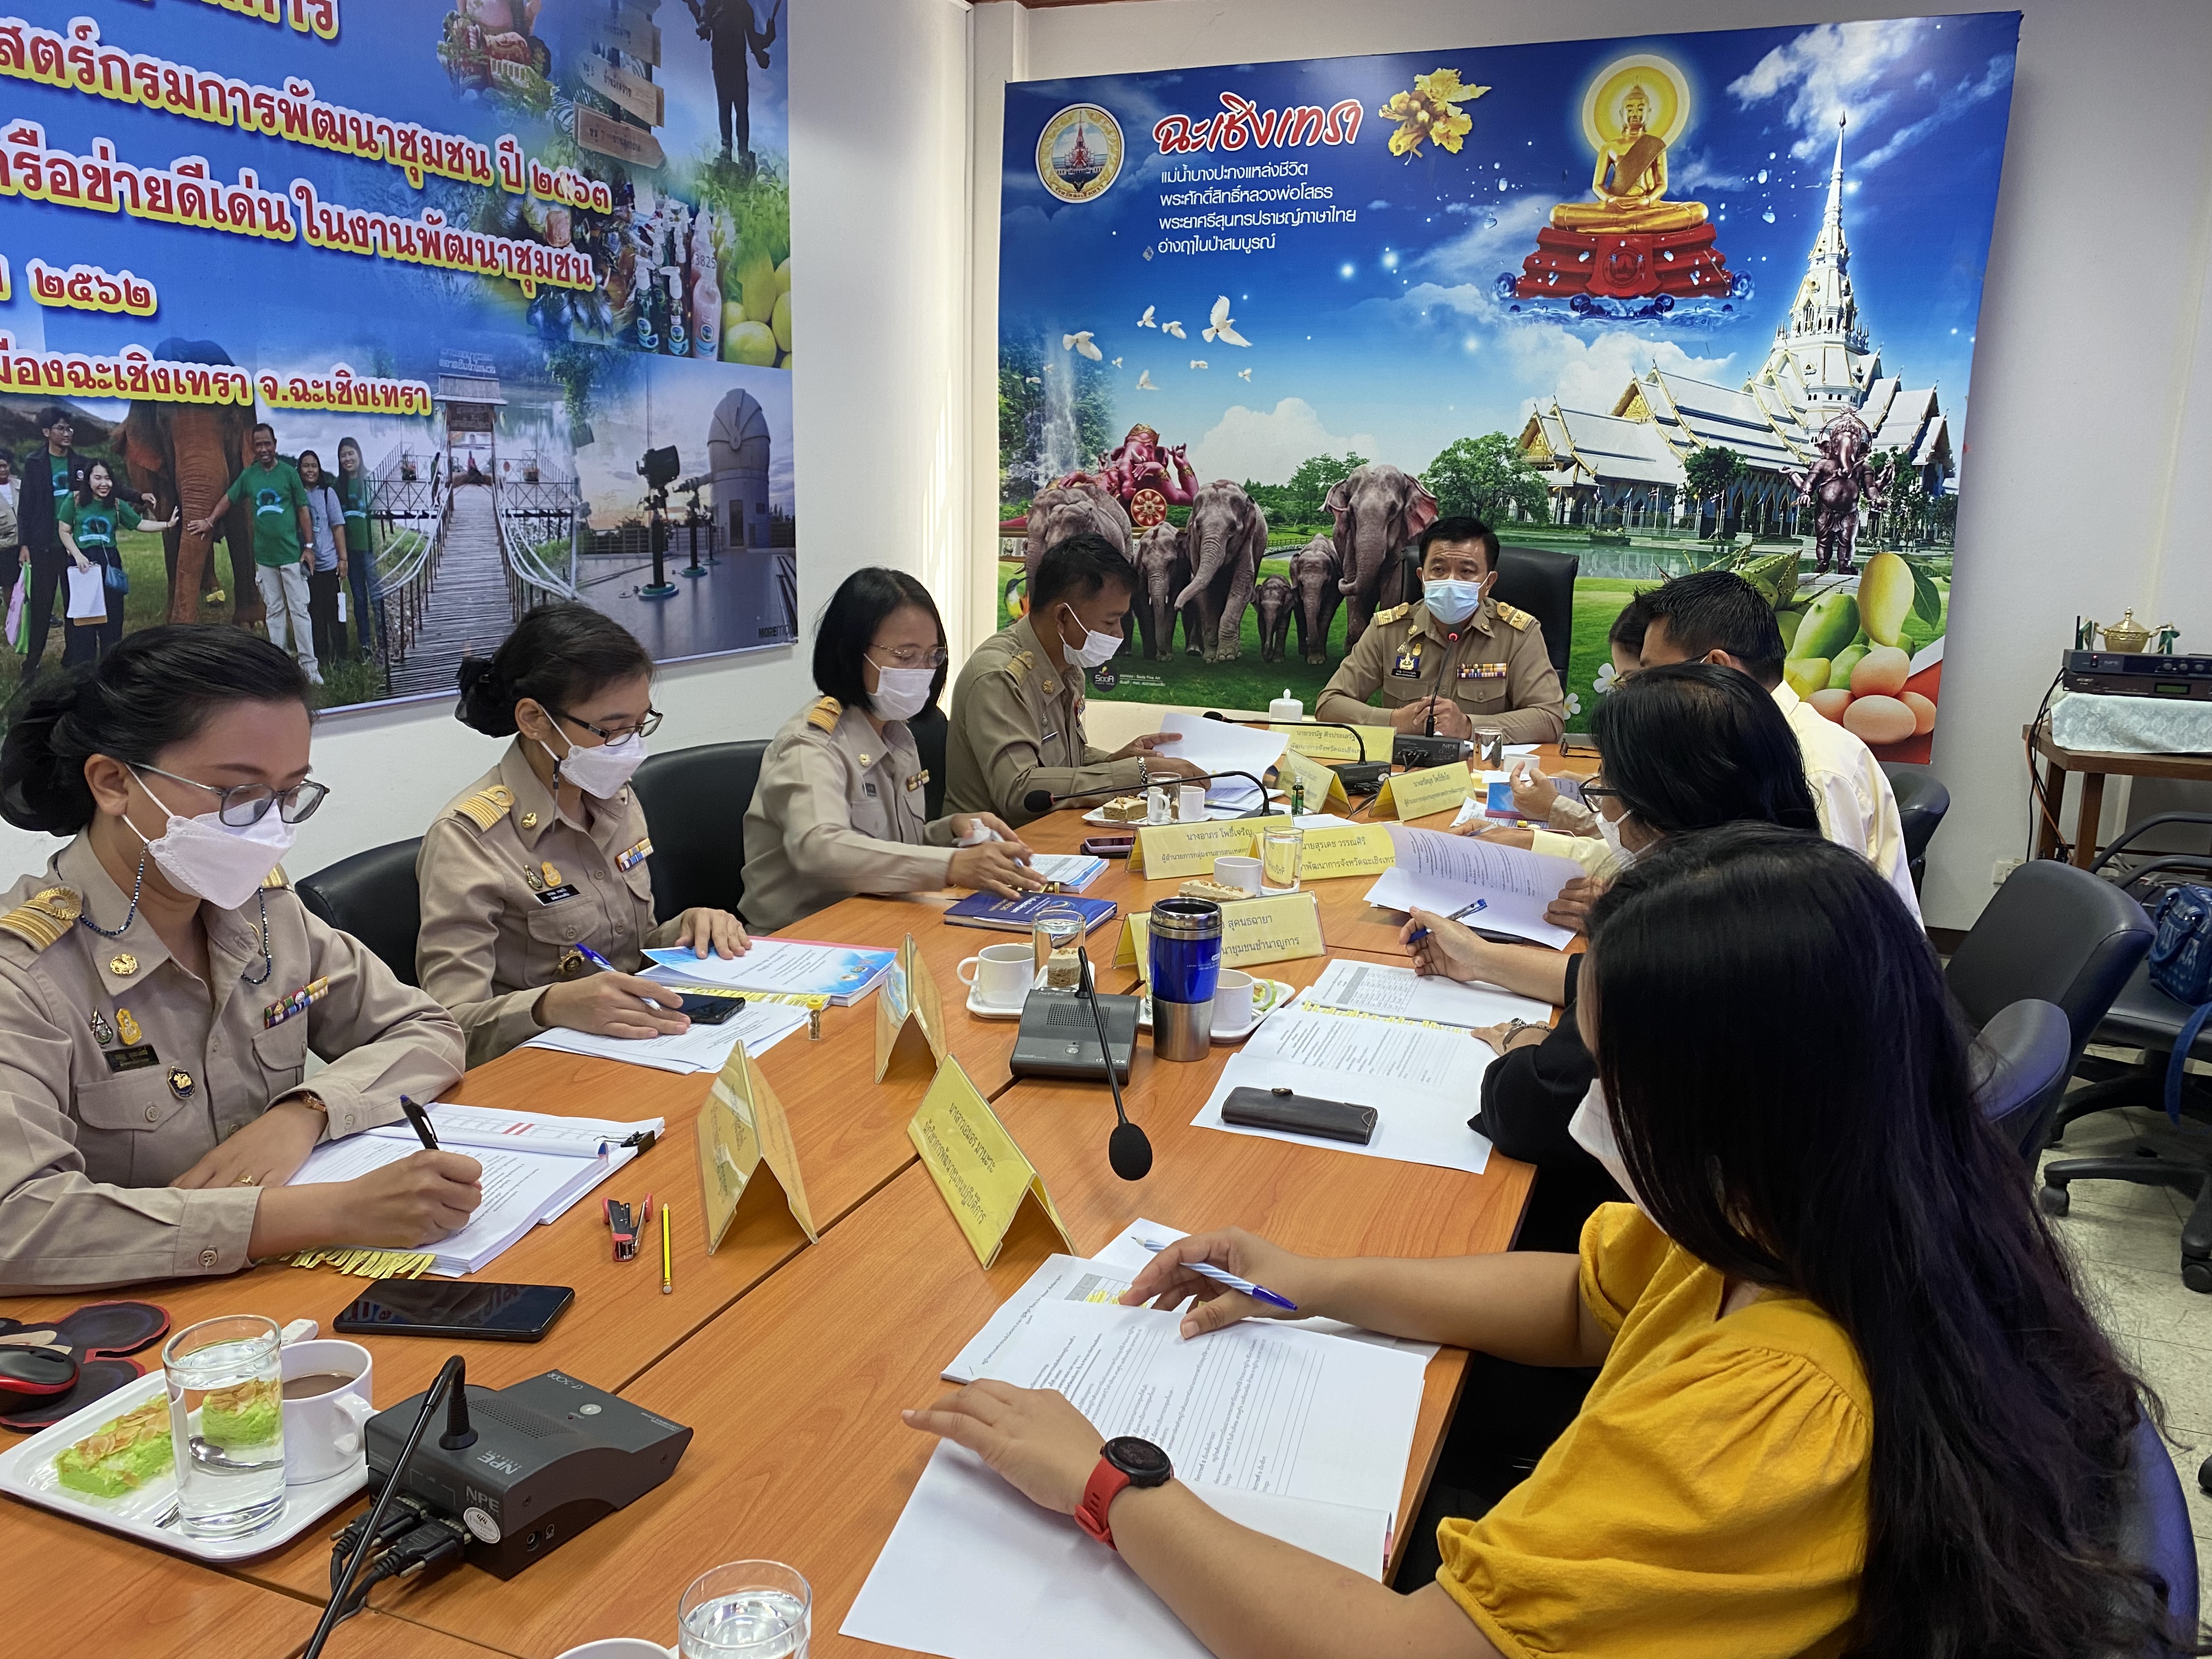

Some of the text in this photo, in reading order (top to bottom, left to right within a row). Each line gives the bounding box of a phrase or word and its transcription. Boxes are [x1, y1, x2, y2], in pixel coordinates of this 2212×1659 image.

[1154, 93, 1362, 154] ฉะเชิงเทรา
[500, 141, 522, 188] ปี
[1161, 161, 1308, 183] แม่น้ำบางปะกงแหล่งชีวิต
[1160, 182, 1334, 206] พระศักดิ์สิทธิ์หลวงพ่อโสธร
[1159, 205, 1357, 231] พระยาศรีสุนทรปราชญ์ภาษาไทย
[296, 185, 592, 292] ในงานพัฒนาชุมชน
[35, 266, 150, 308] ๒๕๖๒
[259, 370, 427, 410] จ.ฉะเชิงเทรา
[1290, 743, 1367, 754] พัฒนาการจังหวัดฉะเชิงเทา
[1187, 826, 1252, 841] นางอาภร โพธิ์เจริญ
[1338, 837, 1365, 847] วรรณศิริ
[1228, 915, 1272, 931] สุคนธฉายา
[923, 1119, 987, 1224] นักวิชาการพัฒนาชุมชนปฏิบัติการ
[477, 1453, 518, 1475] NPE
[466, 1486, 499, 1513] NPE
